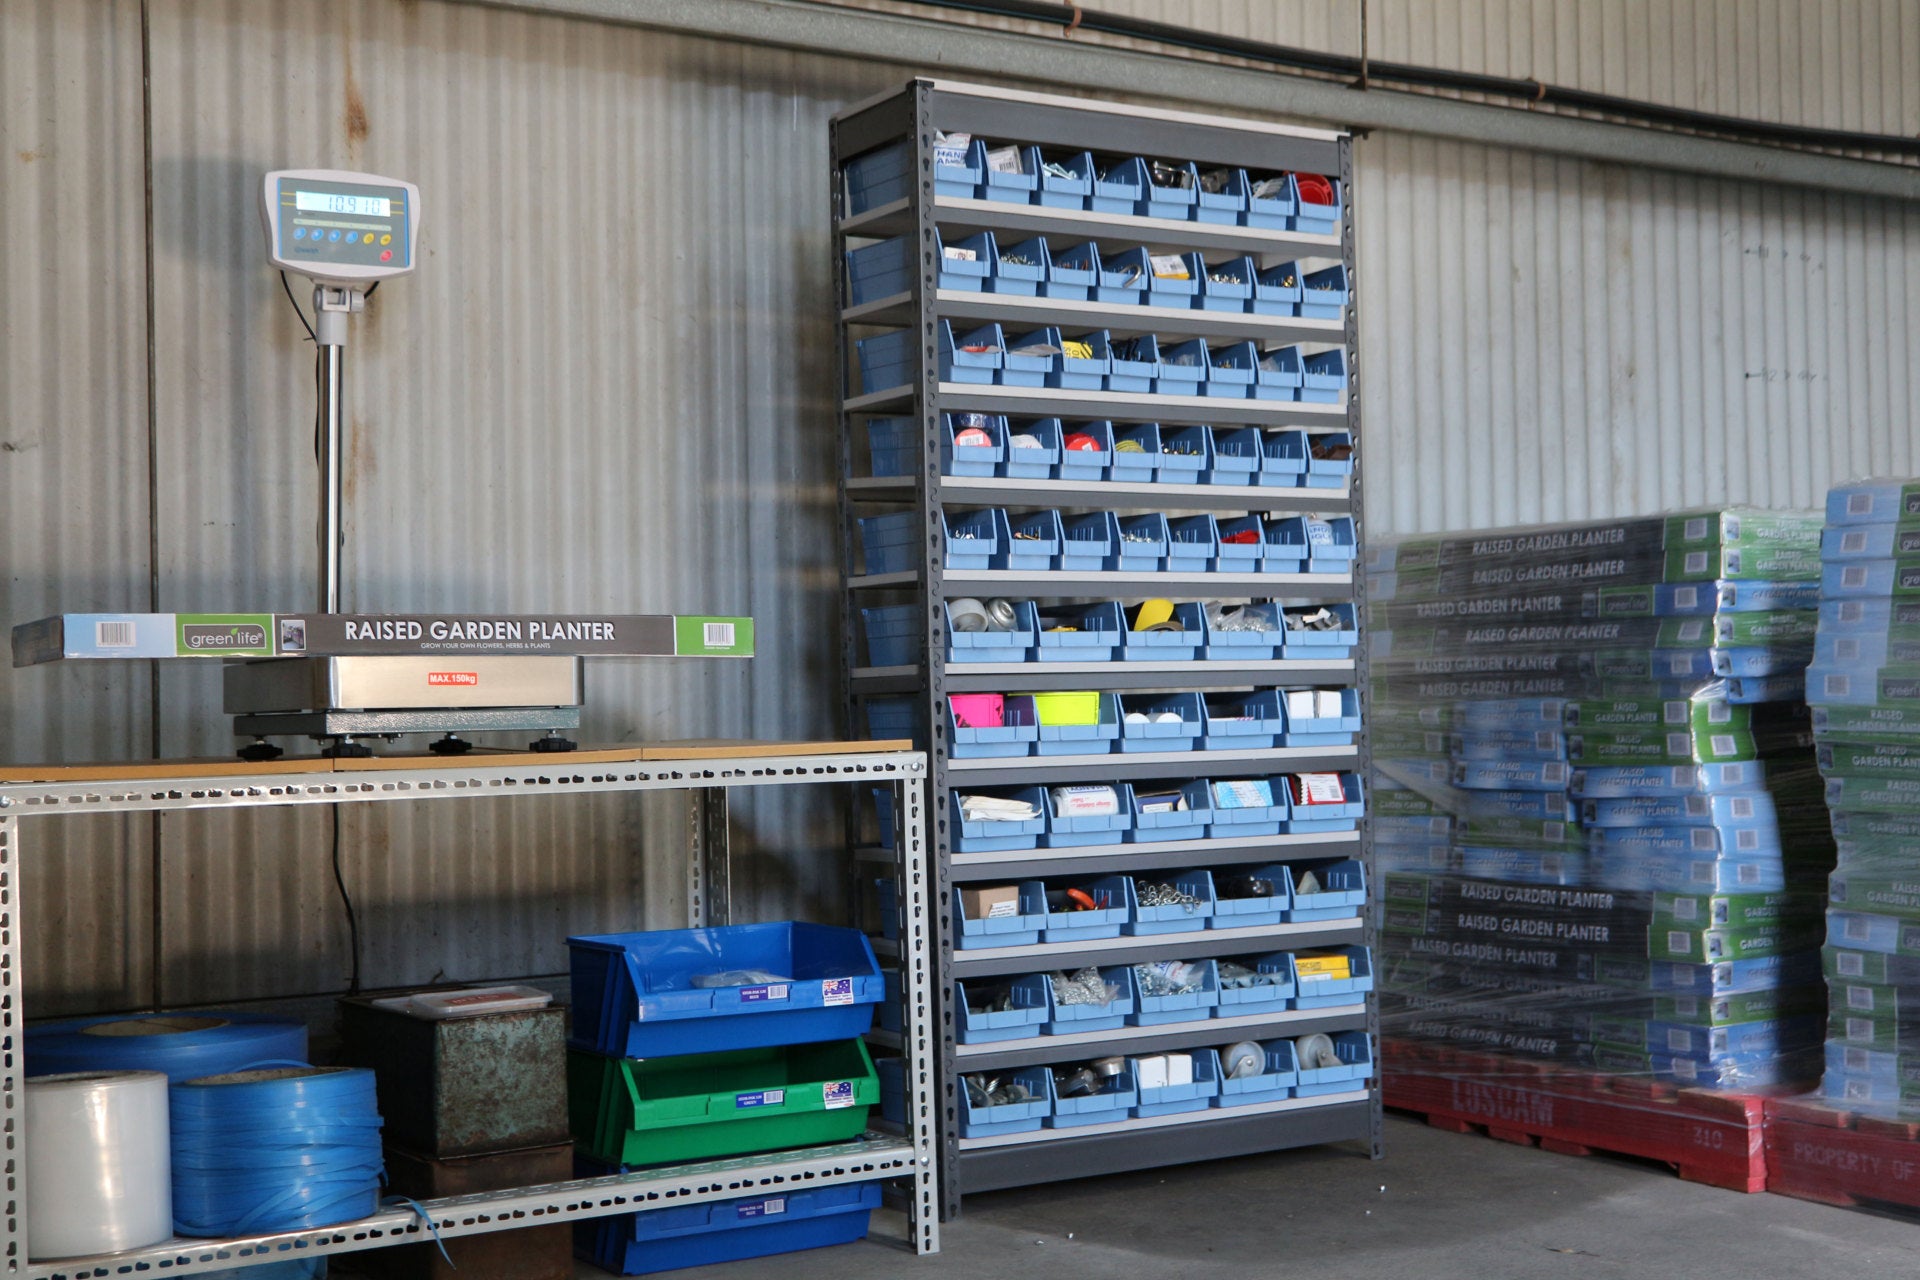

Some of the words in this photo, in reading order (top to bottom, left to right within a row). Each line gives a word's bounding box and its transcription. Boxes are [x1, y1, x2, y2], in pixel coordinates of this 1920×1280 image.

[1472, 539, 1513, 555] RAISED
[1516, 533, 1568, 550] GARDEN
[1571, 528, 1625, 546] PLANTER
[1472, 568, 1512, 584] RAISED
[1516, 564, 1568, 581] GARDEN
[1571, 560, 1625, 577] PLANTER
[1417, 603, 1455, 617] RAISED
[1458, 599, 1507, 614] GARDEN
[1511, 596, 1562, 612] PLANTER
[345, 621, 422, 640] RAISED
[430, 620, 521, 641] GARDEN
[529, 621, 615, 641] PLANTER
[1465, 629, 1505, 643] RAISED
[1508, 626, 1561, 641] GARDEN
[1564, 624, 1620, 639] PLANTER
[191, 634, 233, 648] green
[1454, 655, 1504, 671] GARDEN
[1507, 655, 1557, 671] PLANTER
[1419, 683, 1455, 697] RAISED
[1460, 680, 1510, 695] GARDEN
[1513, 679, 1565, 693] PLANTER
[1595, 713, 1626, 721] GARDEN
[1871, 710, 1904, 720] RAISED
[1875, 746, 1907, 755] RAISED
[1852, 755, 1891, 766] GARDEN
[1631, 777, 1664, 787] PLANTER
[1861, 790, 1901, 801] GARDEN
[1460, 883, 1500, 900] RAISED
[1504, 886, 1556, 905] GARDEN
[1559, 890, 1614, 910] PLANTER
[1457, 913, 1499, 932] RAISED
[1501, 917, 1553, 936] GARDEN
[1556, 922, 1609, 942] PLANTER
[1411, 938, 1449, 954] RAISED
[1452, 941, 1501, 960] GARDEN
[1505, 947, 1557, 968] PLANTER
[1408, 1021, 1447, 1037] RAISED
[1449, 1025, 1500, 1044] GARDEN
[1504, 1034, 1558, 1054] PLANTER
[1793, 1142, 1881, 1175] PROPERTY
[1891, 1160, 1915, 1181] OF
